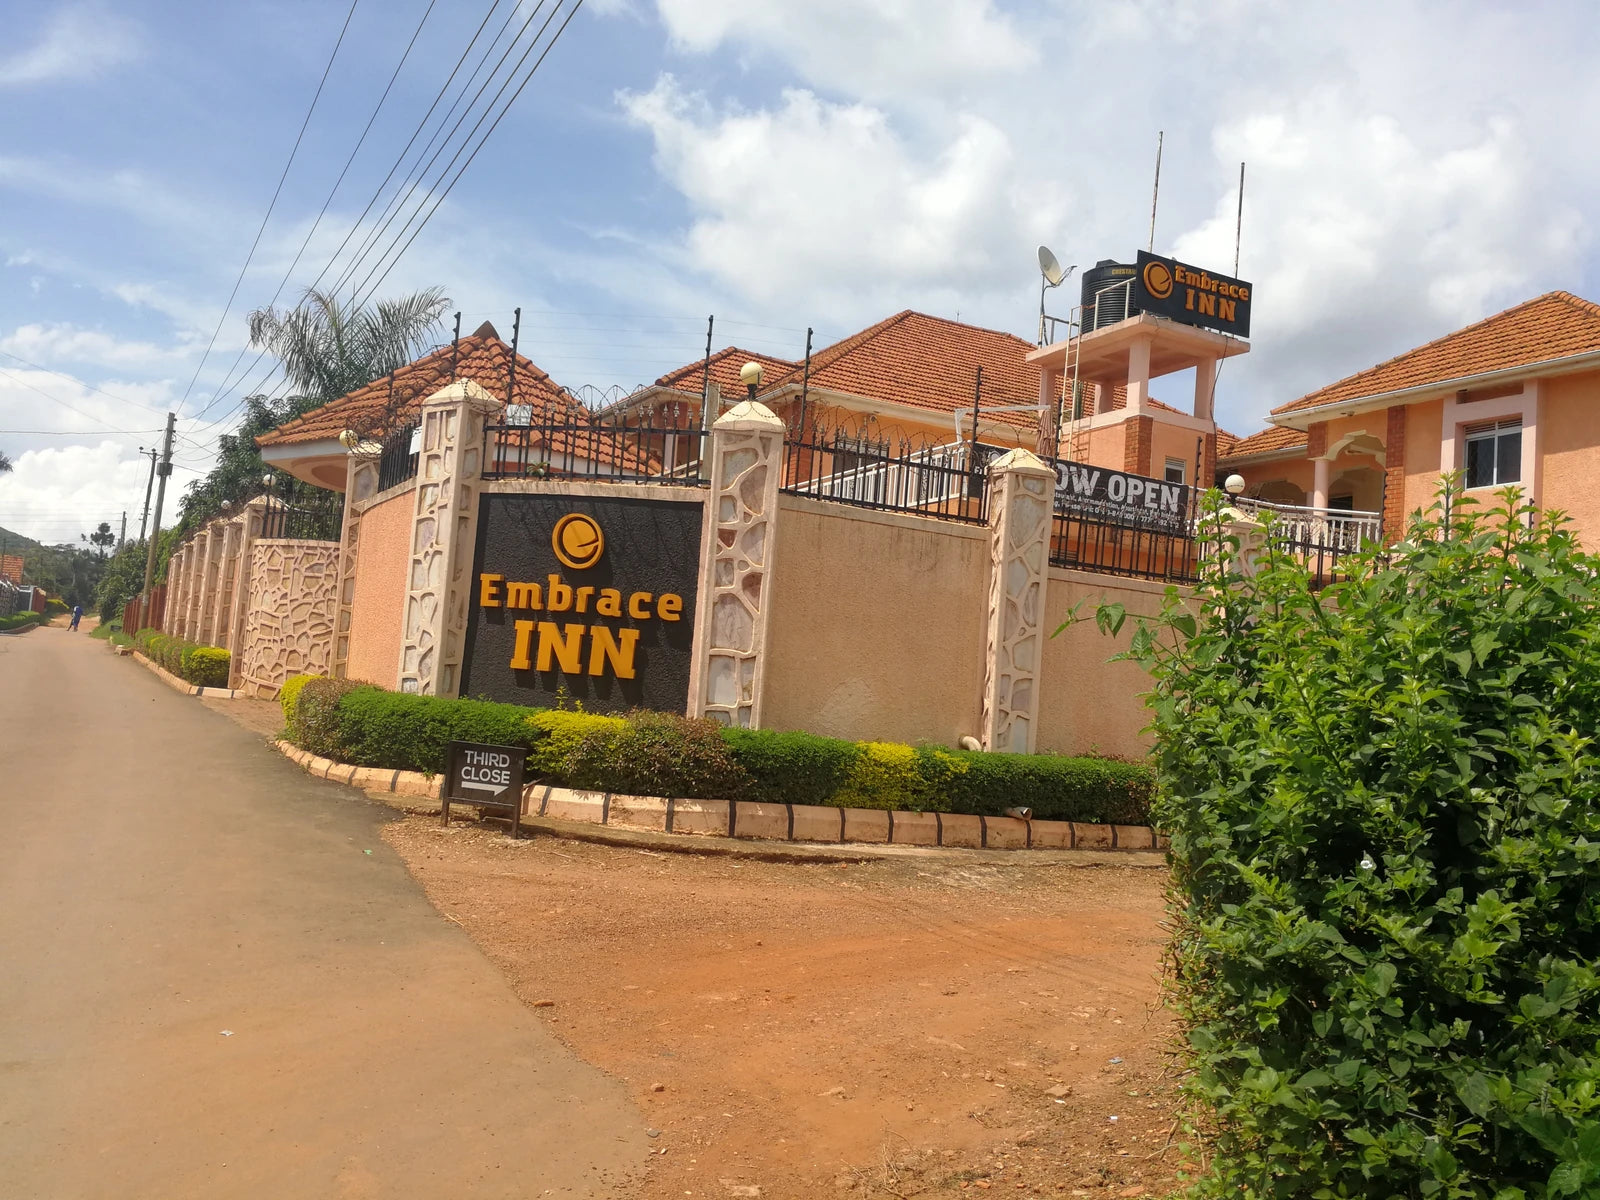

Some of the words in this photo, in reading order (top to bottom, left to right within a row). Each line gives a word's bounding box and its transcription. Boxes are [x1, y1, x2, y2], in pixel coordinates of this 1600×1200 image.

[1175, 265, 1249, 301] Embrace
[1186, 288, 1236, 322] INN
[1108, 474, 1180, 513] OPEN
[480, 572, 683, 622] Embrace
[509, 619, 640, 680] INN
[461, 766, 511, 784] CLOSE
[465, 749, 510, 768] THIRD
